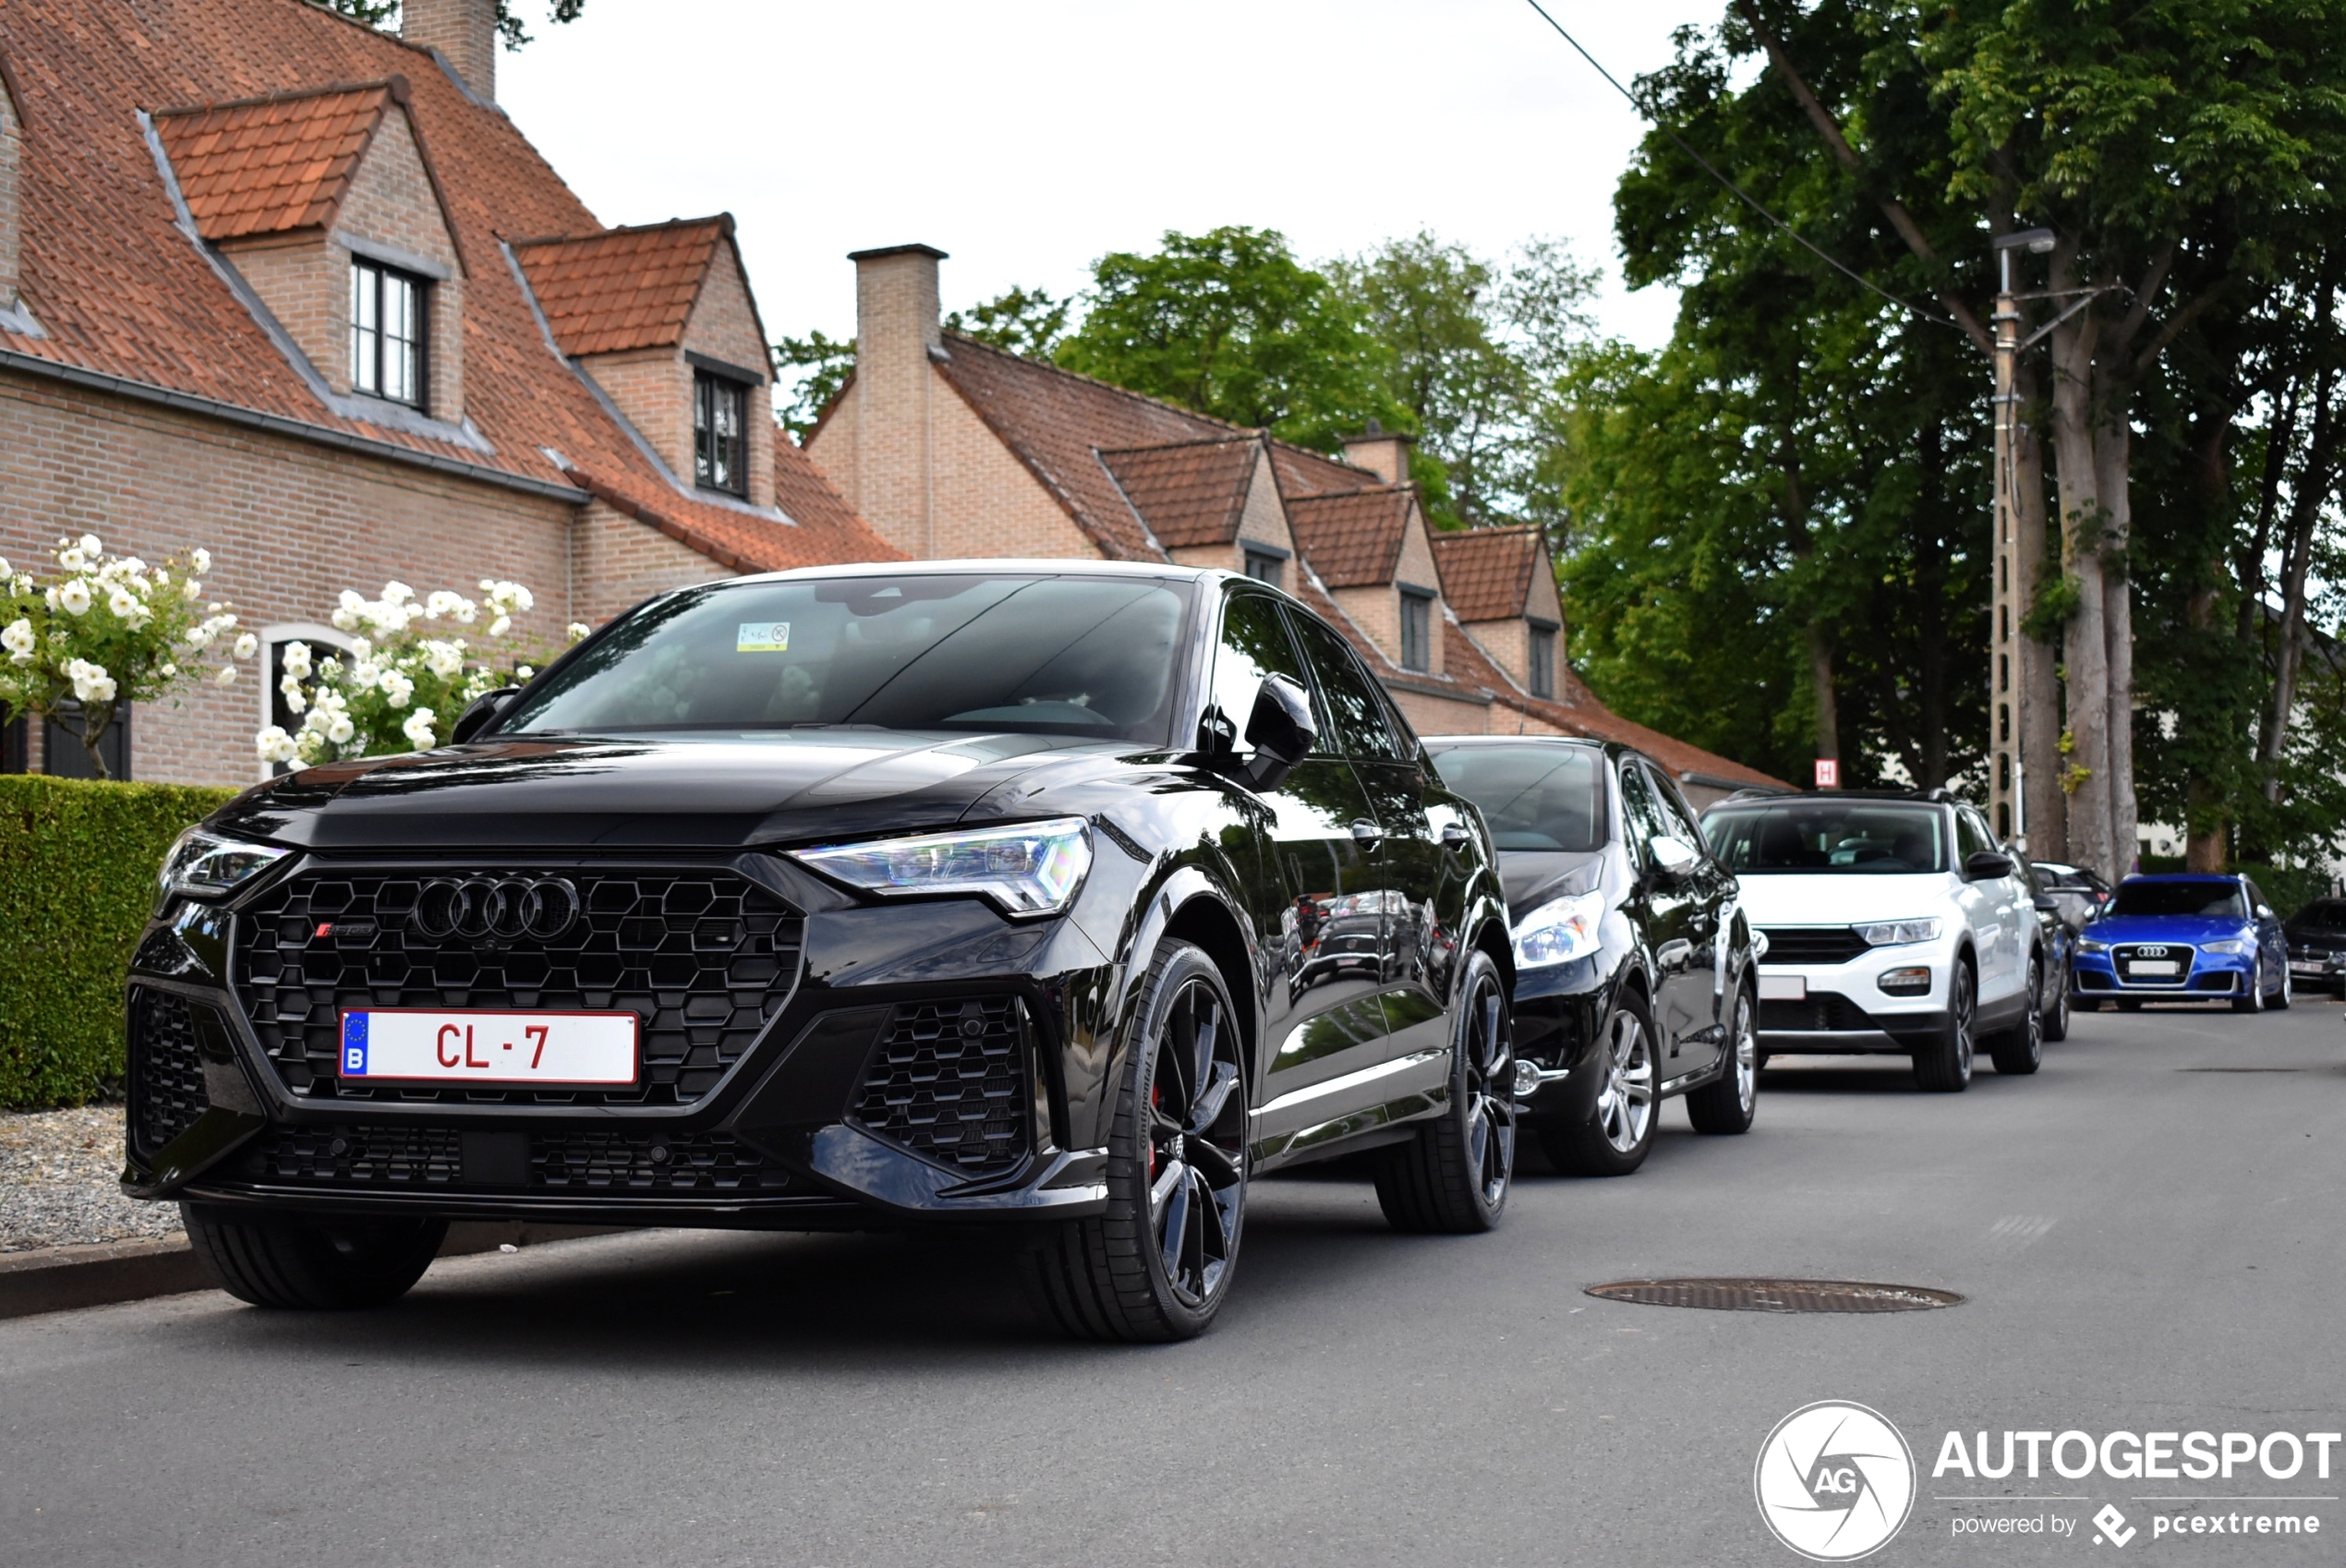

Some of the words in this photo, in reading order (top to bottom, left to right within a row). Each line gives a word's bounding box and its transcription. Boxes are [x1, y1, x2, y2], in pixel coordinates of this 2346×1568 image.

[1820, 763, 1832, 782] H
[347, 1048, 363, 1069] B
[1140, 1062, 1153, 1151] Continental
